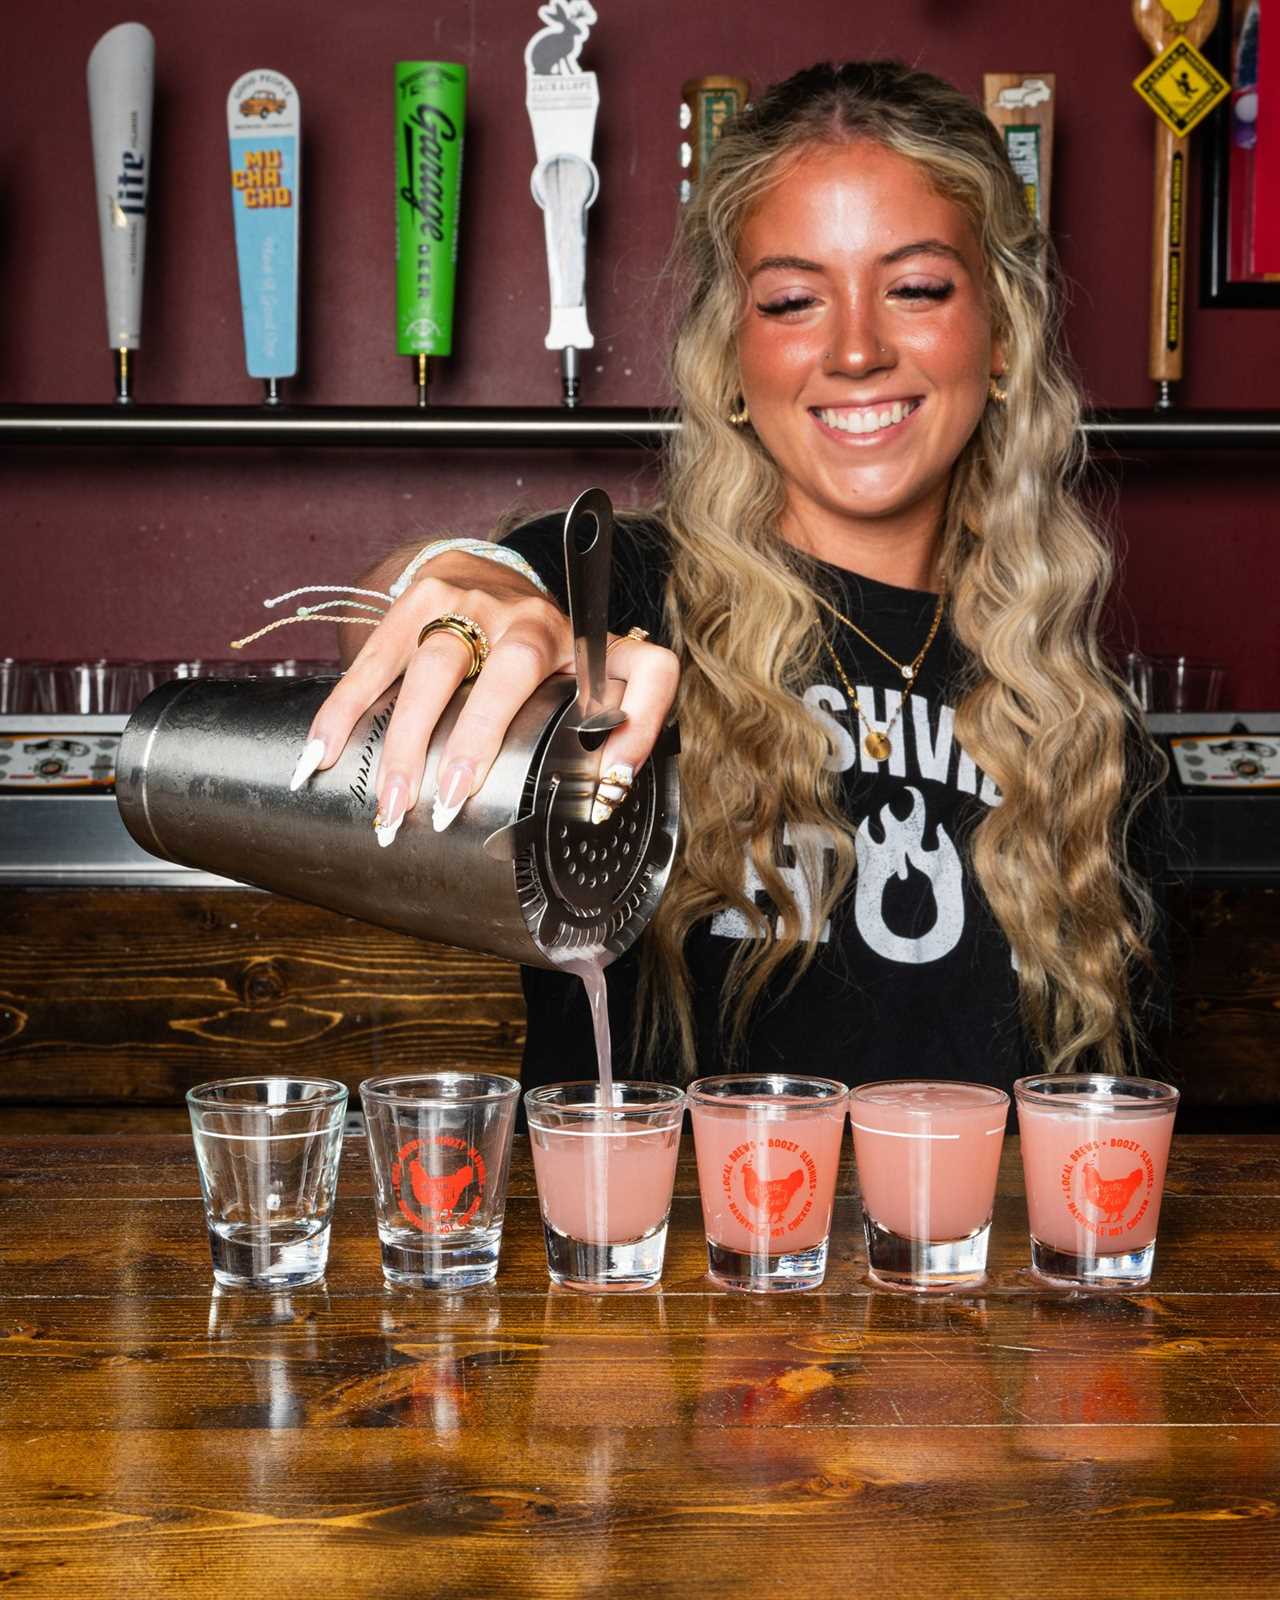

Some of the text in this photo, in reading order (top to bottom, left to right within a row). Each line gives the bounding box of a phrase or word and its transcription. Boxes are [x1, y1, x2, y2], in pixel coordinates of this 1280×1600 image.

[117, 151, 146, 216] lite
[232, 169, 281, 191] CHA
[244, 148, 283, 170] MU
[400, 103, 457, 242] Garage
[417, 244, 431, 298] BEER
[723, 1165, 733, 1192] LOCAL
[768, 1138, 800, 1153] BOOZY
[800, 1151, 816, 1189] SLUSHIES
[1061, 1164, 1074, 1192] LOCAL
[1070, 1140, 1100, 1163] BREWS
[1110, 1138, 1141, 1153] BOOZY
[788, 1200, 812, 1231] CHICKEN
[1126, 1199, 1151, 1231] CHICKEN
